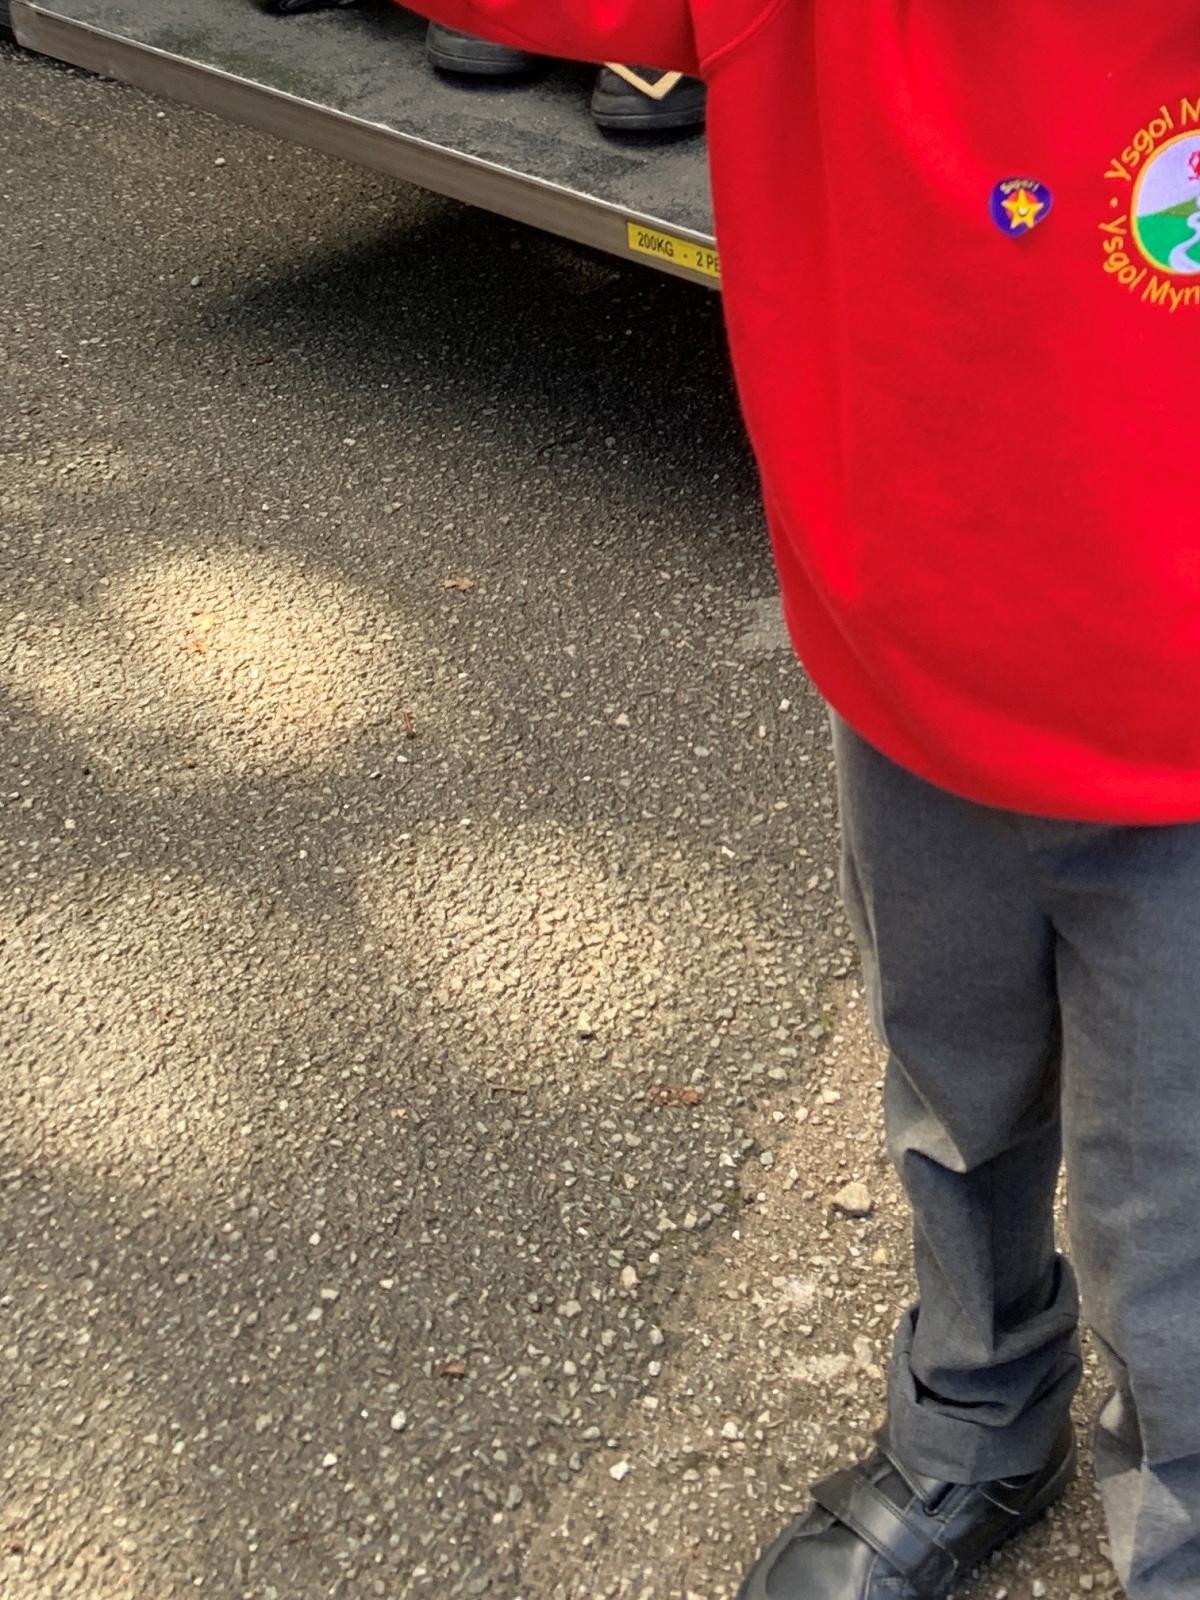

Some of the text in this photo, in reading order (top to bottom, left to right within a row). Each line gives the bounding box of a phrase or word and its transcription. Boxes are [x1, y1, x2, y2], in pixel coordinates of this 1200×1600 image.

[1103, 105, 1174, 182] Ysgol
[637, 231, 674, 258] 200KG
[696, 251, 703, 268] 2
[1098, 214, 1147, 293] Ysgol
